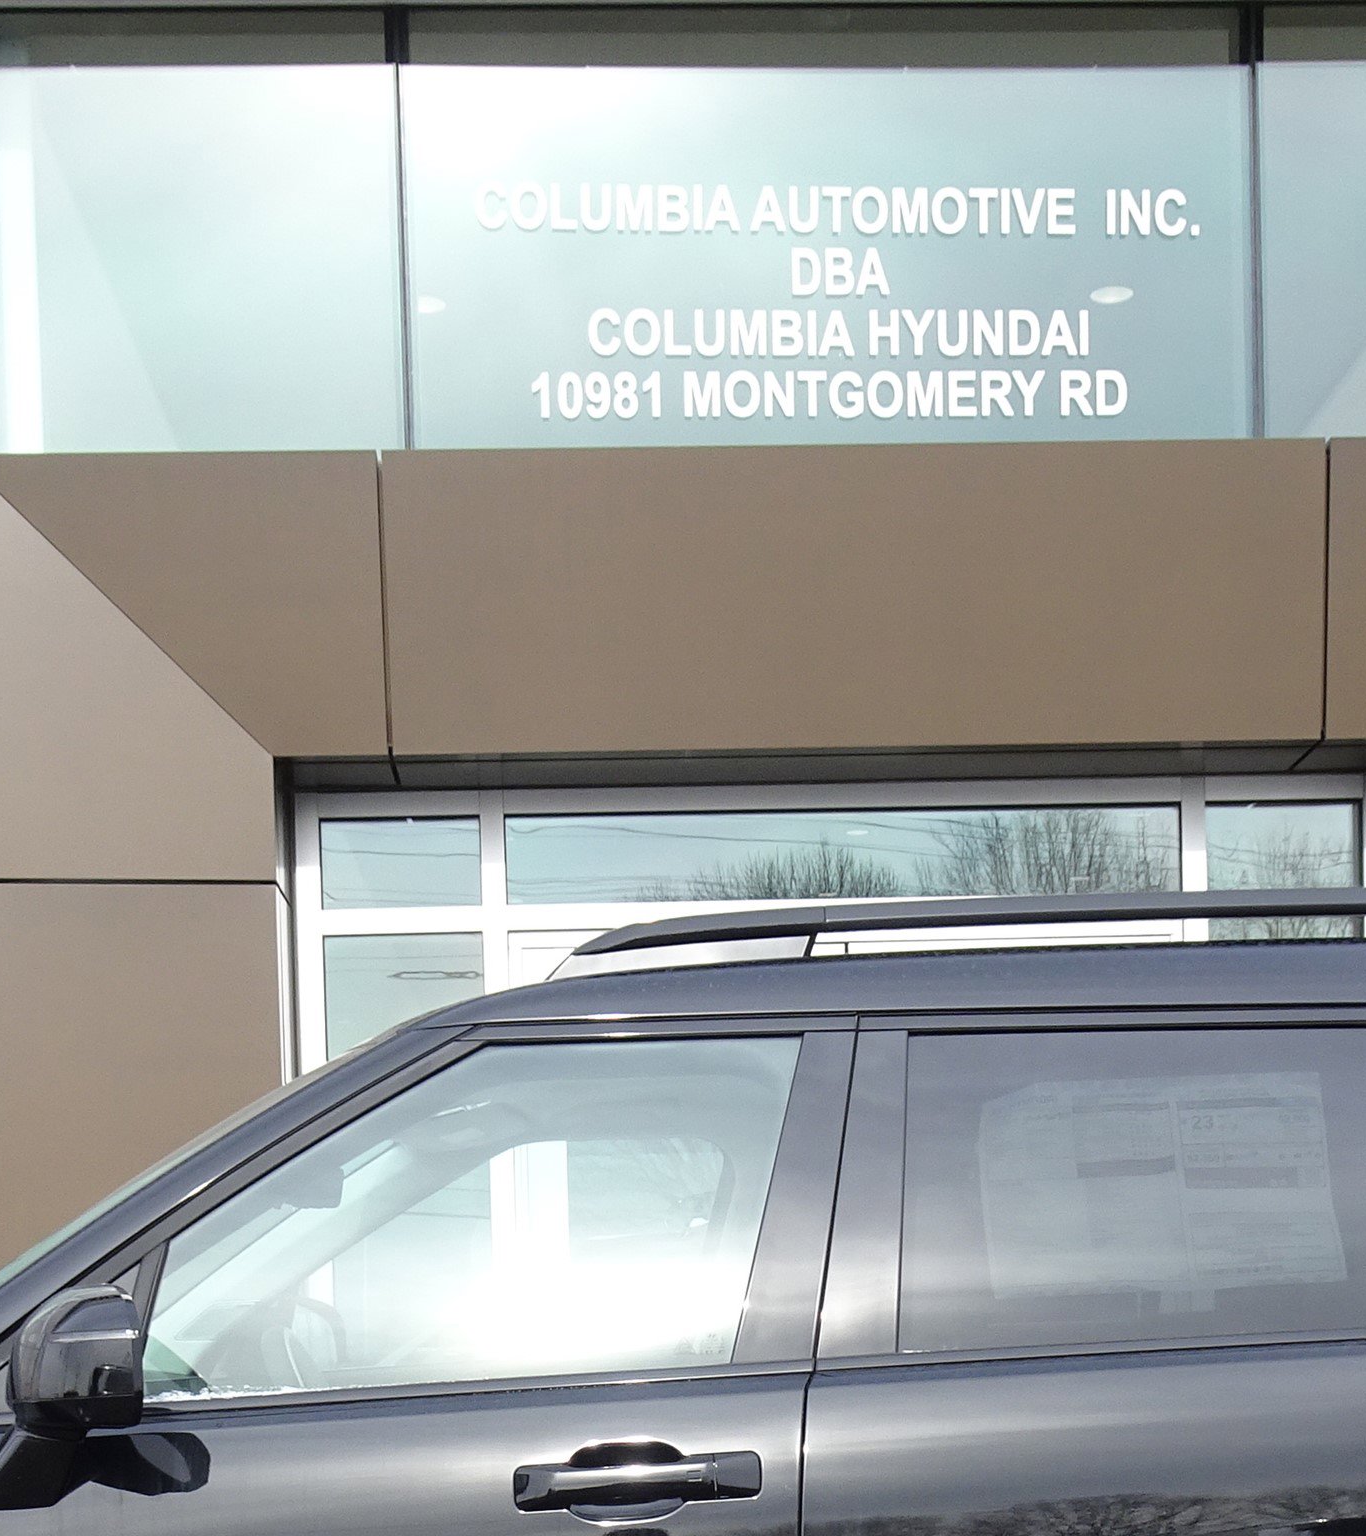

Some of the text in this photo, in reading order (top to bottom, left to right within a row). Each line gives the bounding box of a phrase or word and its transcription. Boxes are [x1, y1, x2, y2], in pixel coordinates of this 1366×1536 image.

[474, 182, 1201, 237] COLUMBIA AUTOMOTIVE INC.
[790, 247, 891, 297] DBA
[587, 307, 1090, 358] COLUMBIA HYUNDAI
[530, 369, 1129, 420] 10981 MONTGOMERY RD
